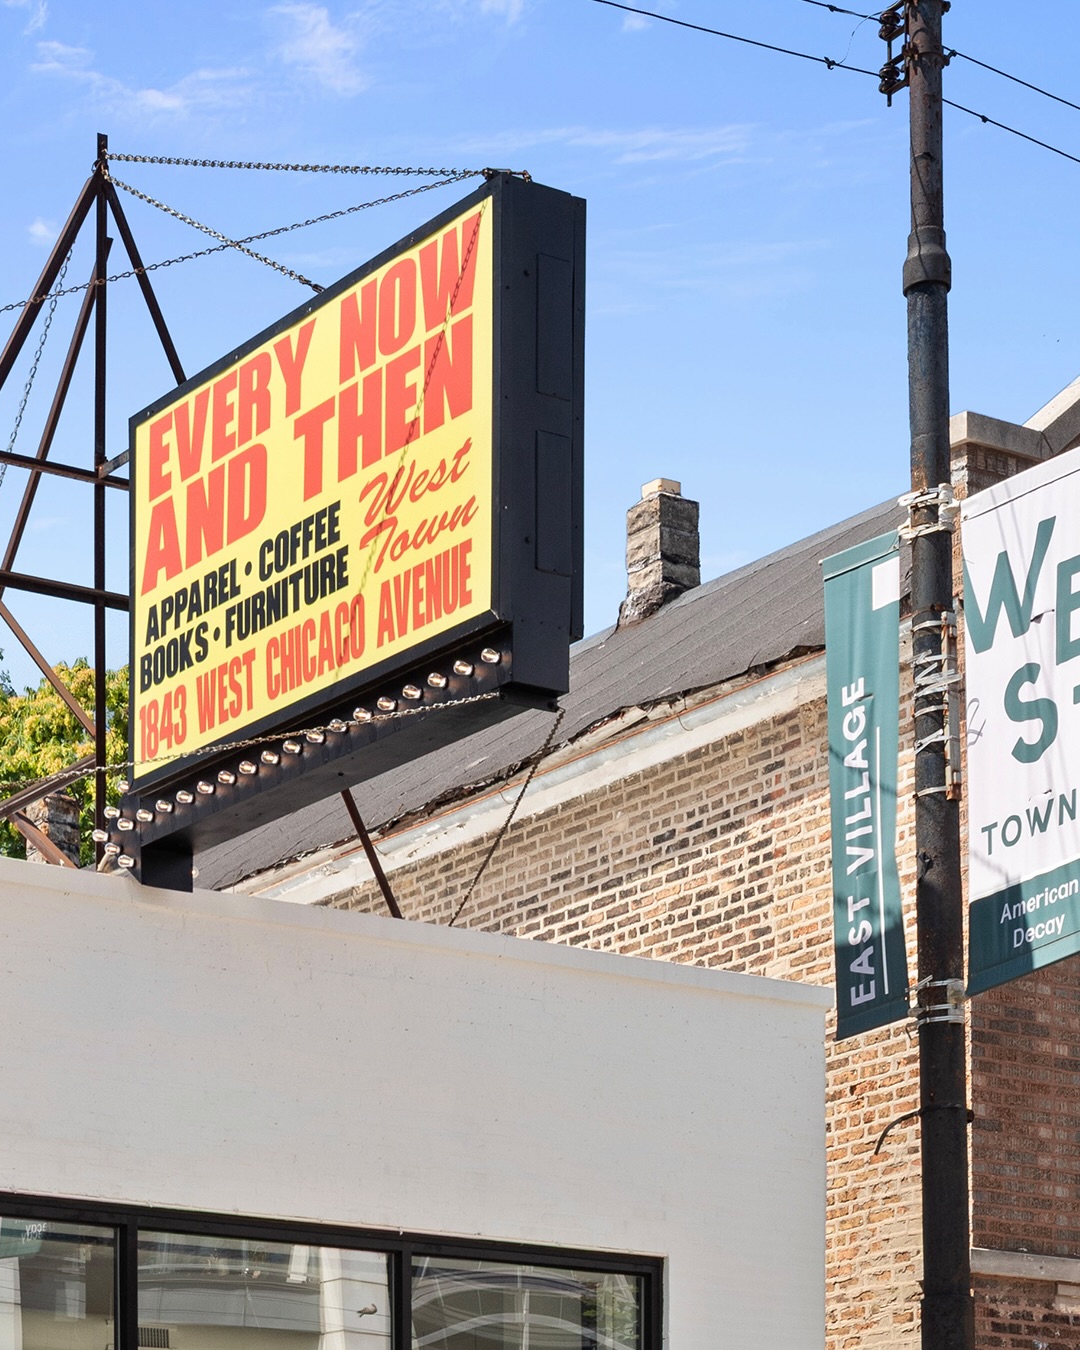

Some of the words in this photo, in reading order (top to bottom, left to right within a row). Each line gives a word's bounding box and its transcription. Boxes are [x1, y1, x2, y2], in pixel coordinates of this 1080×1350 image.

[149, 319, 317, 503] EVERY
[339, 212, 482, 386] NOW
[140, 443, 268, 597] AND
[292, 312, 474, 503] THEN
[359, 437, 474, 527] West
[145, 559, 241, 646] APPAREL
[258, 500, 342, 583] COFFEE
[359, 494, 478, 575] Town
[138, 684, 188, 762] 1843
[196, 647, 256, 734] WEST
[265, 592, 365, 700] CHICAGO
[376, 538, 473, 648] AVENUE
[140, 621, 208, 693] BOOKS
[225, 544, 349, 648] FURNITURE
[841, 676, 875, 875] VILLAGE
[981, 788, 1077, 855] TOWN
[847, 894, 876, 1007] EAST
[1000, 878, 1079, 924] American
[1013, 913, 1066, 949] Decay
